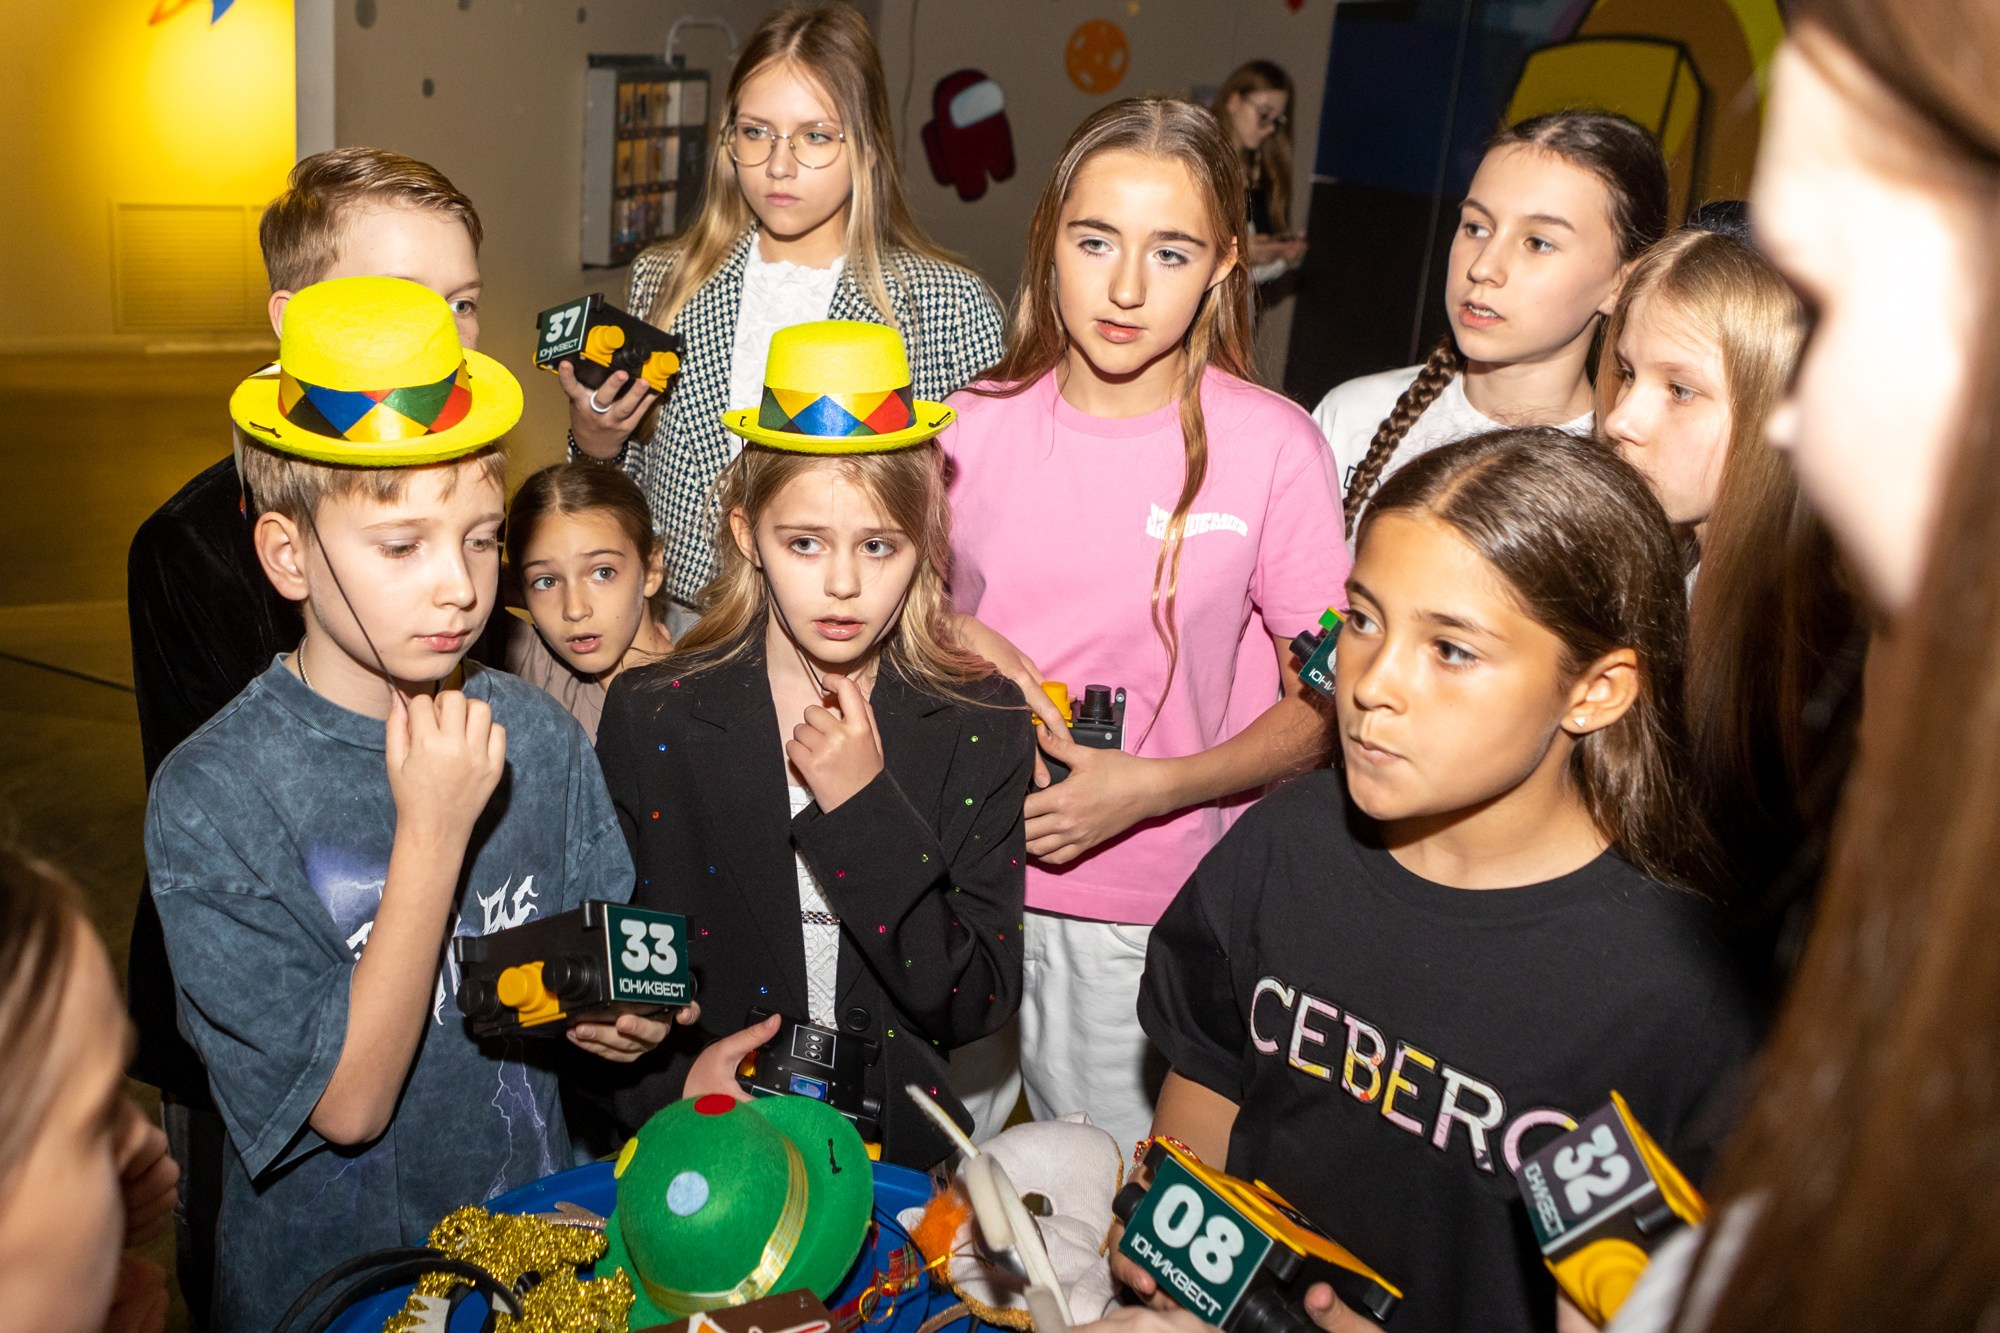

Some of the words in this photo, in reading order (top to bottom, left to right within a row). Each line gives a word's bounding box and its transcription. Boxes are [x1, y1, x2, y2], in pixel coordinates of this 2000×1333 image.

[545, 305, 581, 343] 37
[620, 918, 678, 975] 33
[619, 977, 686, 998] ЮНИКВЕСТ
[1553, 1123, 1631, 1215] 32
[1152, 1182, 1245, 1285] 08
[1130, 1231, 1222, 1317] ЮНИКВЕСТ
